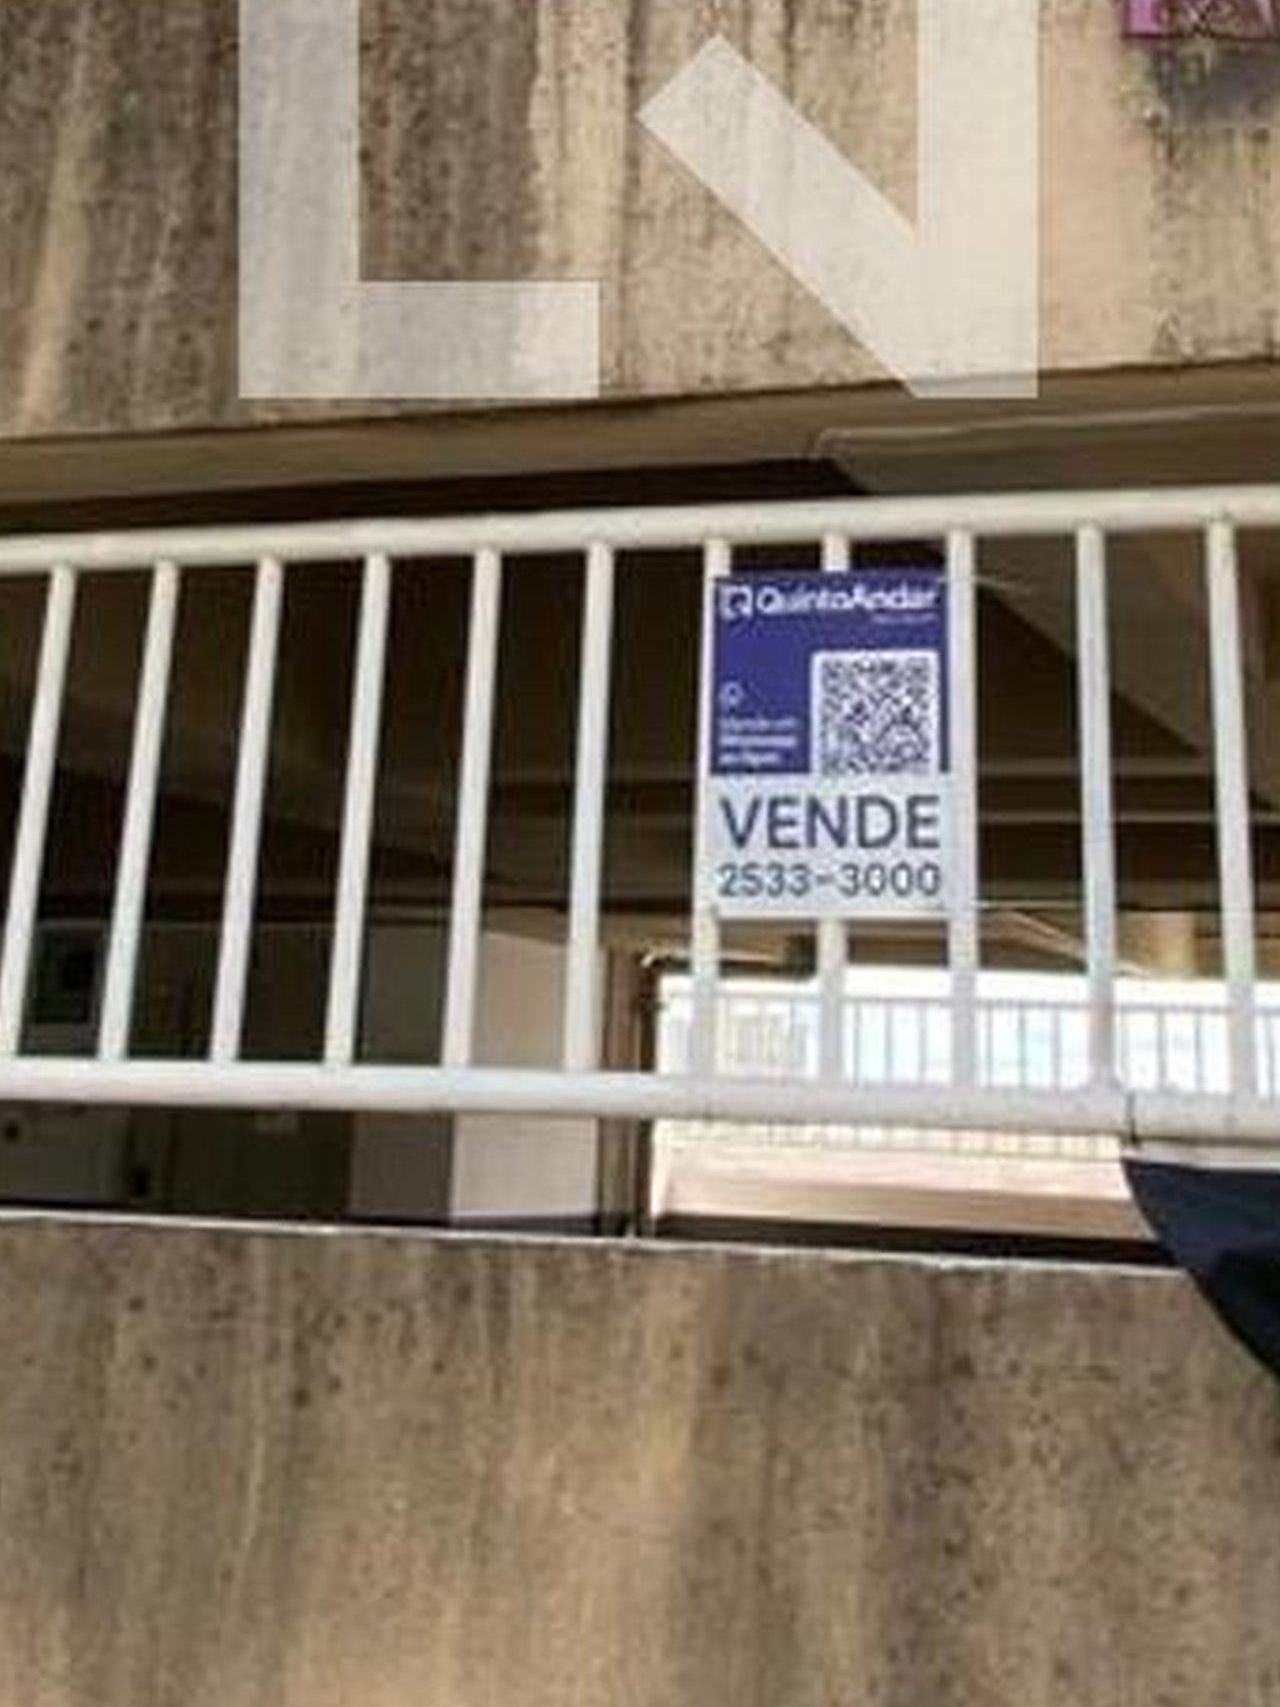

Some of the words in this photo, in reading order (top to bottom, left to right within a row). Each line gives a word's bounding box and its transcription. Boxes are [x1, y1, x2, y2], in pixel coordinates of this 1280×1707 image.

[756, 582, 937, 614] QuintoAndar
[720, 794, 940, 852] VENDE
[718, 861, 941, 898] 2533-3000
